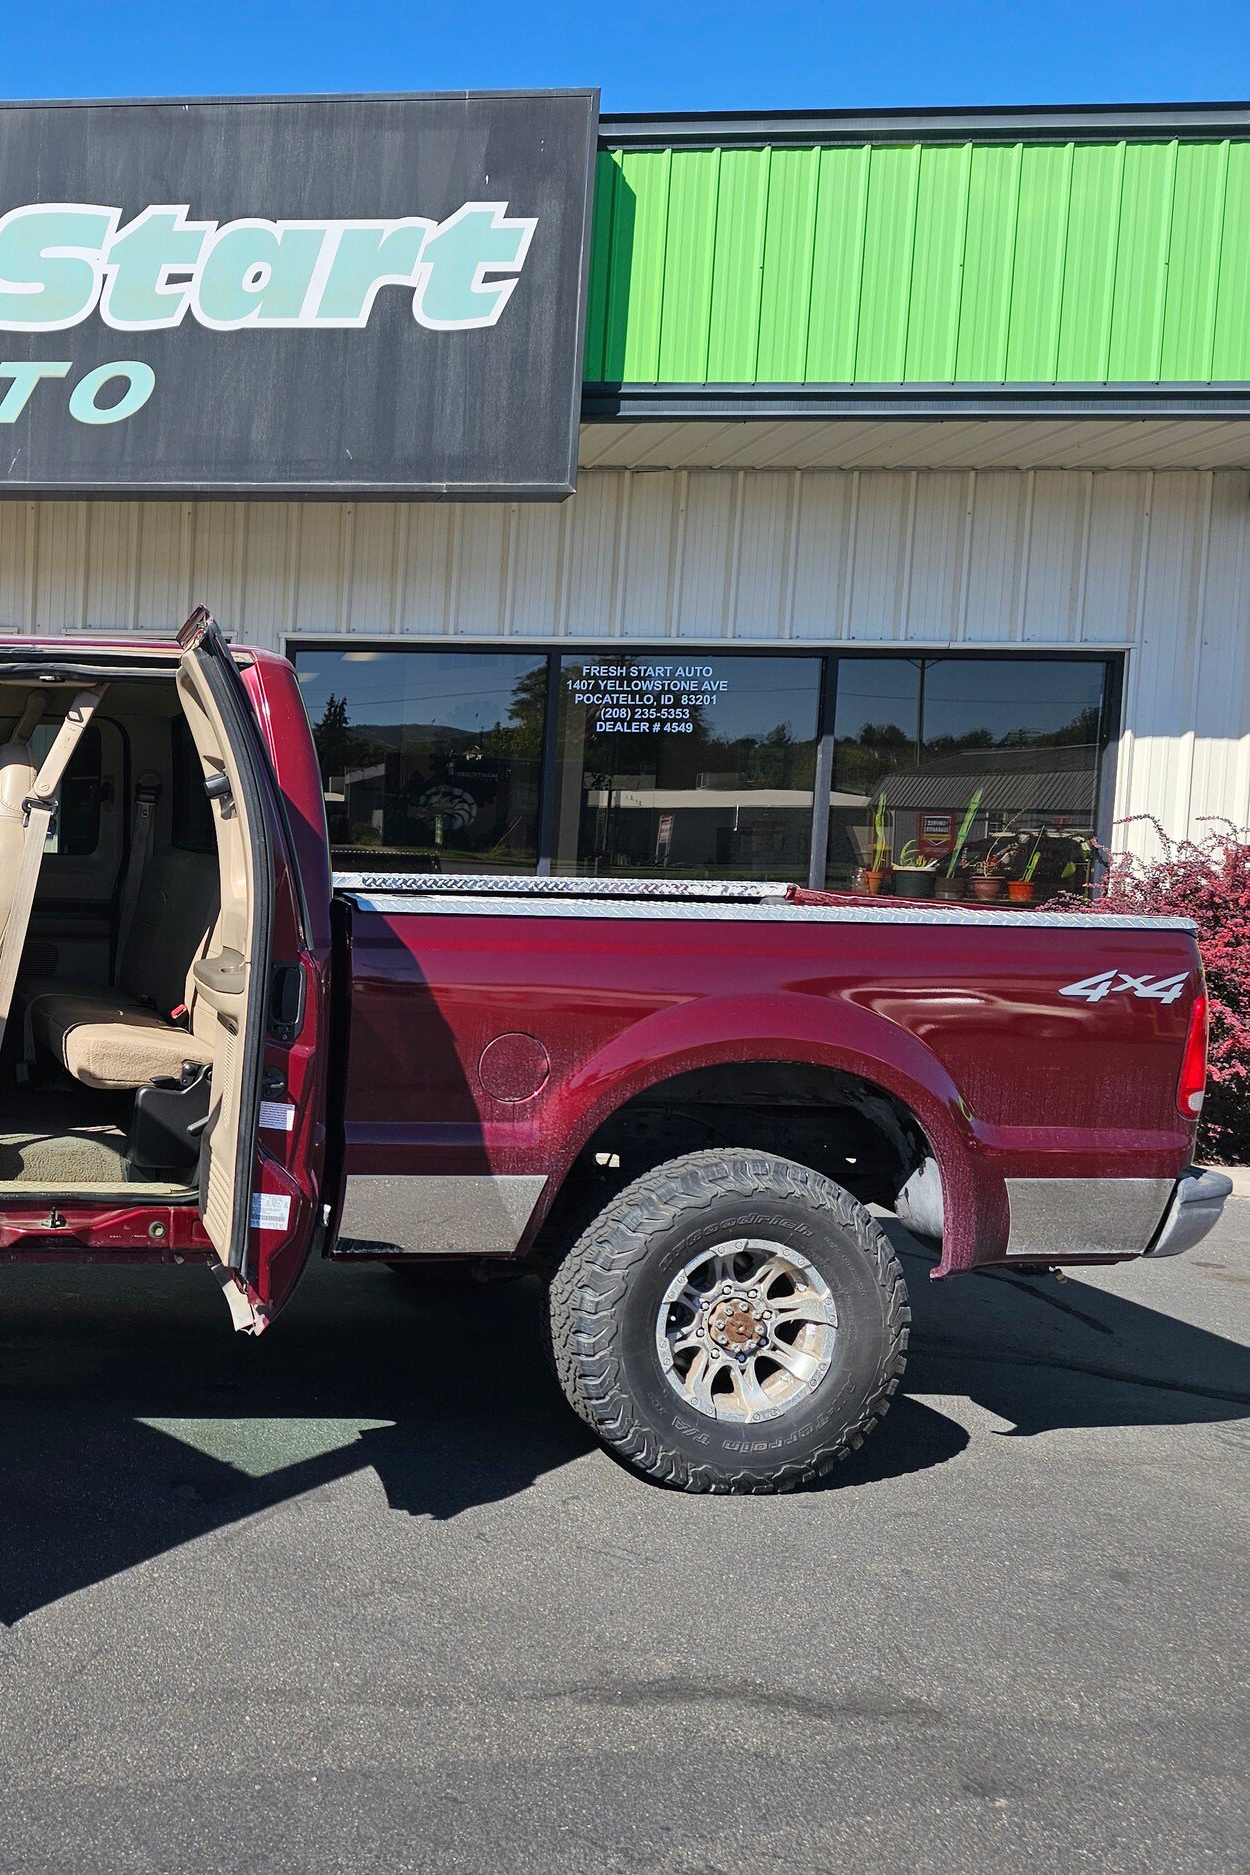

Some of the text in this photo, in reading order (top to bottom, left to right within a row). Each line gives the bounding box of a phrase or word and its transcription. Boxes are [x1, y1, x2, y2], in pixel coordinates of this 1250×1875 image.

[582, 666, 713, 677] FRESH START AUTO
[566, 680, 728, 691] 1407 YELLOWSTONE AVE
[575, 694, 717, 707] POCATELLO, ID 83201
[600, 708, 690, 720] (208) 235-5353
[596, 722, 693, 733] DEALER # 4549
